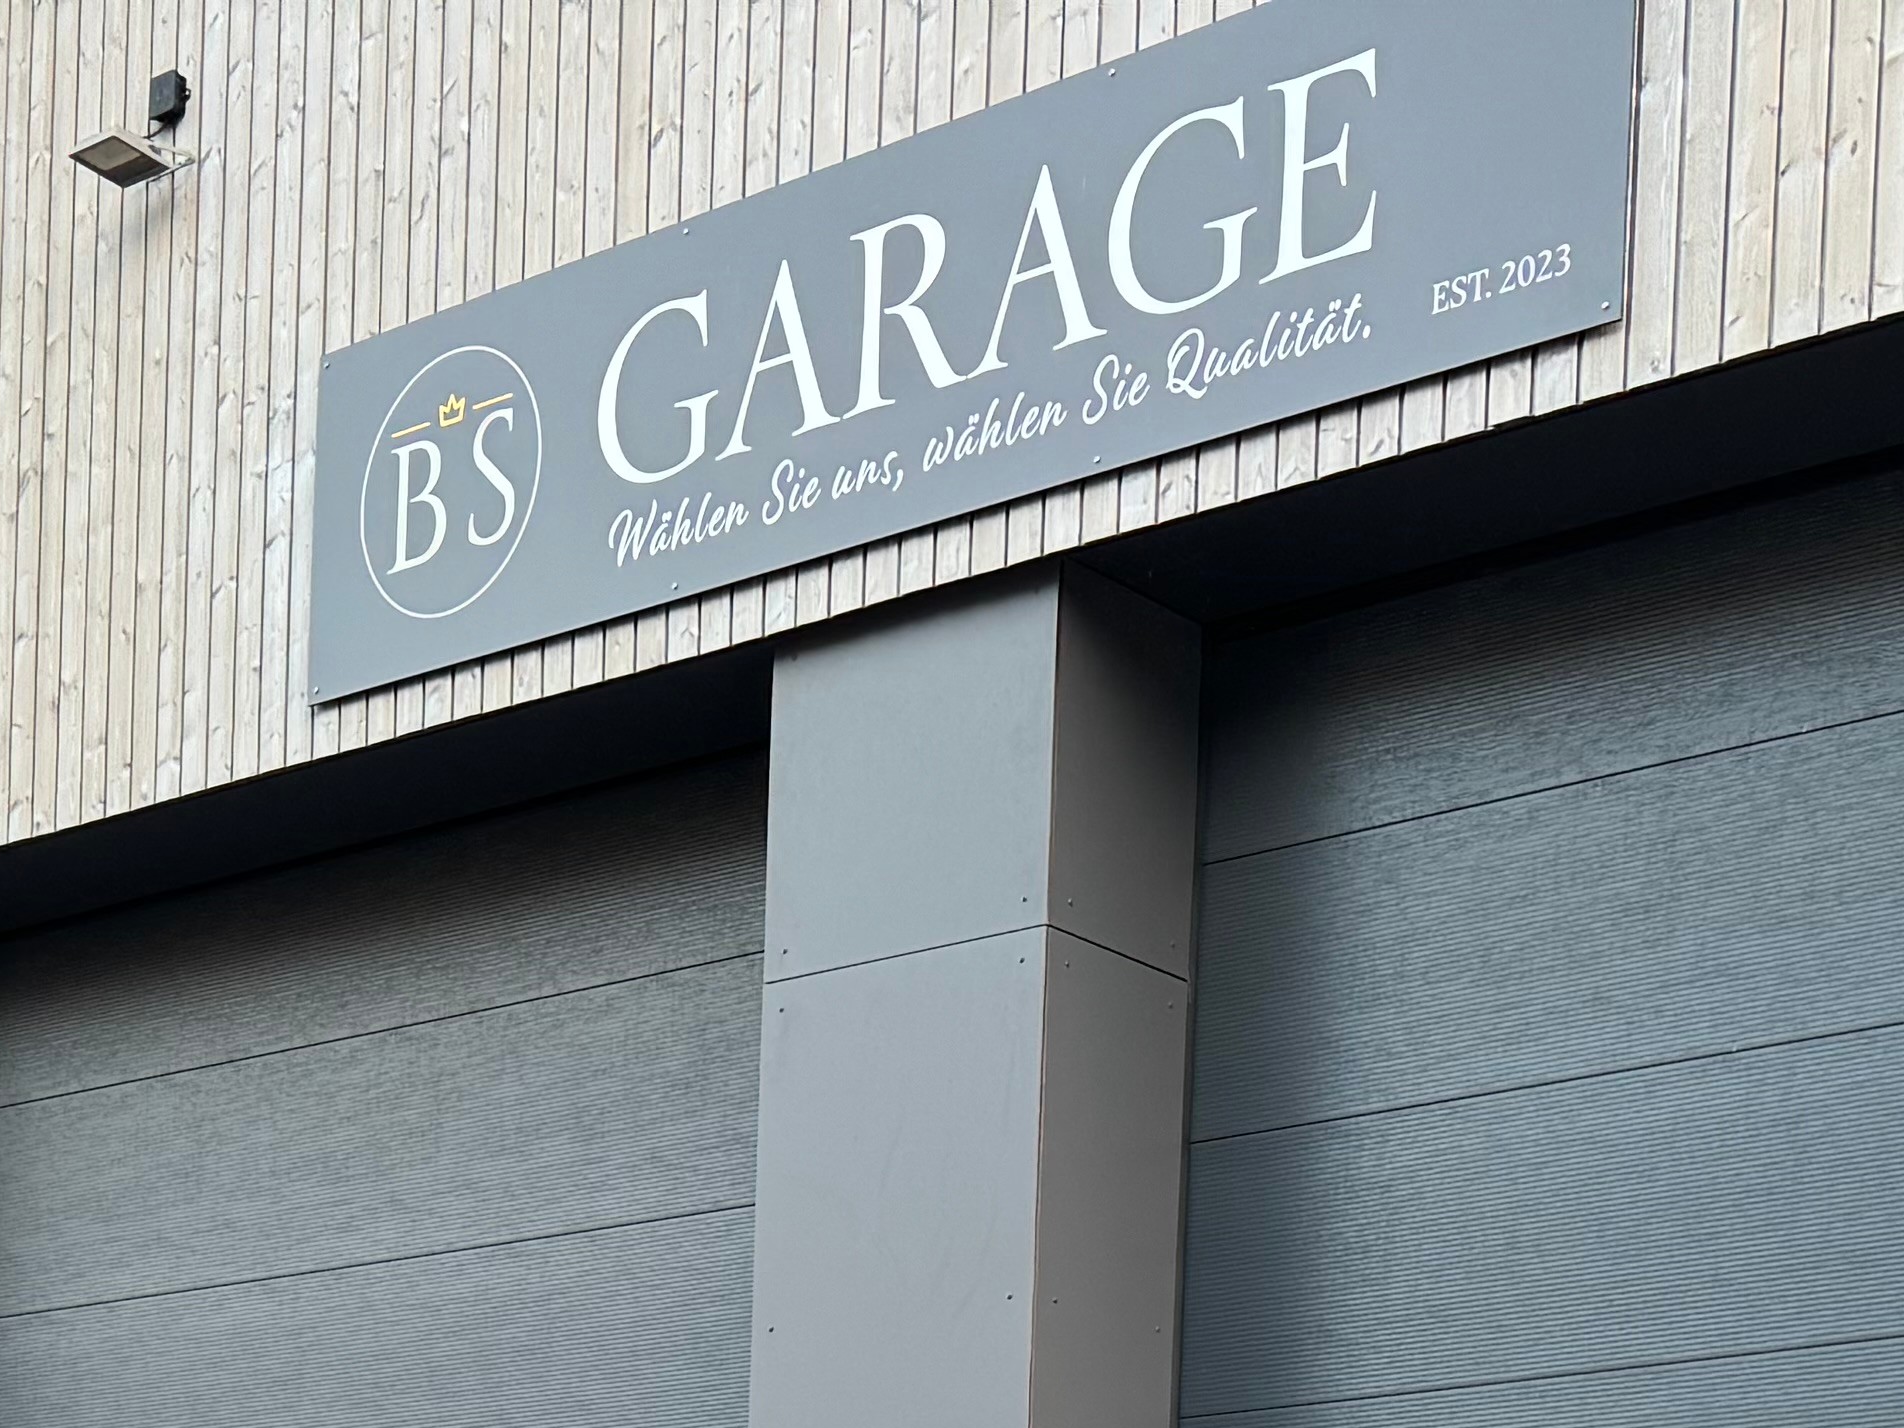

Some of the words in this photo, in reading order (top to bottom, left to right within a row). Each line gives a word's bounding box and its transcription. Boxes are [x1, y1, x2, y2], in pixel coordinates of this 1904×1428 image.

[597, 47, 1379, 484] GARAGE
[1431, 268, 1492, 315] EST.
[1498, 243, 1572, 294] 2023
[608, 491, 749, 568] Wählen
[761, 458, 822, 525] Sie
[831, 450, 904, 498] uns,
[922, 391, 1068, 472] wählen
[1081, 353, 1150, 426] Sie
[1166, 292, 1372, 400] Qualität.
